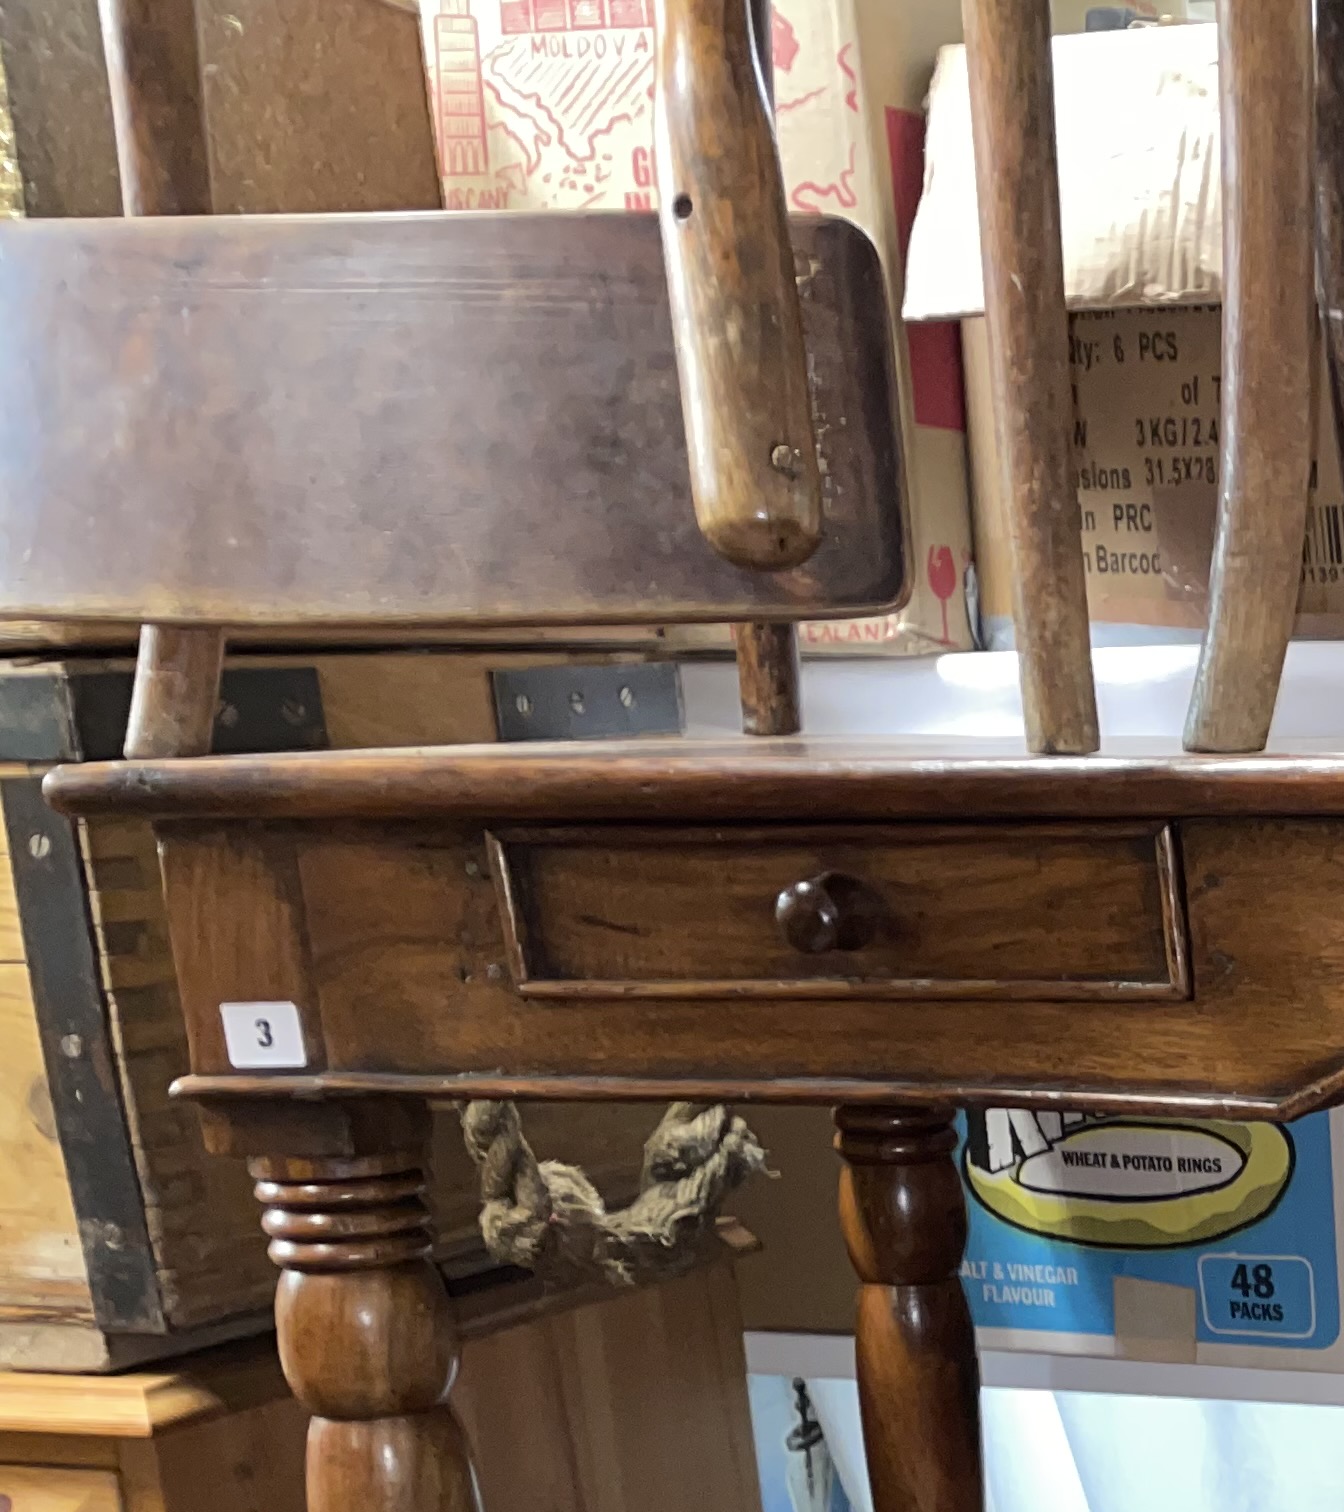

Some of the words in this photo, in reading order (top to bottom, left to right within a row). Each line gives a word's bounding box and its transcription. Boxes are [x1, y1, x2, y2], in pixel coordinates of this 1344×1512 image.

[531, 35, 649, 59] MOLDOVA
[1113, 334, 1124, 363] 6
[1139, 331, 1178, 361] PCS
[1181, 375, 1199, 405] of
[1113, 503, 1153, 532] PRC
[255, 1018, 274, 1048] 3
[1062, 1151, 1108, 1168] WHEAT
[1110, 1153, 1121, 1168] &
[1123, 1154, 1172, 1171] POTATO
[1178, 1156, 1222, 1173] RINGS
[961, 1258, 987, 1280] ALT
[1007, 1262, 1078, 1285] VINEGAR
[1230, 1263, 1275, 1299] 48
[983, 1284, 1056, 1307] FLAVOUR
[1230, 1300, 1283, 1321] PACKS
